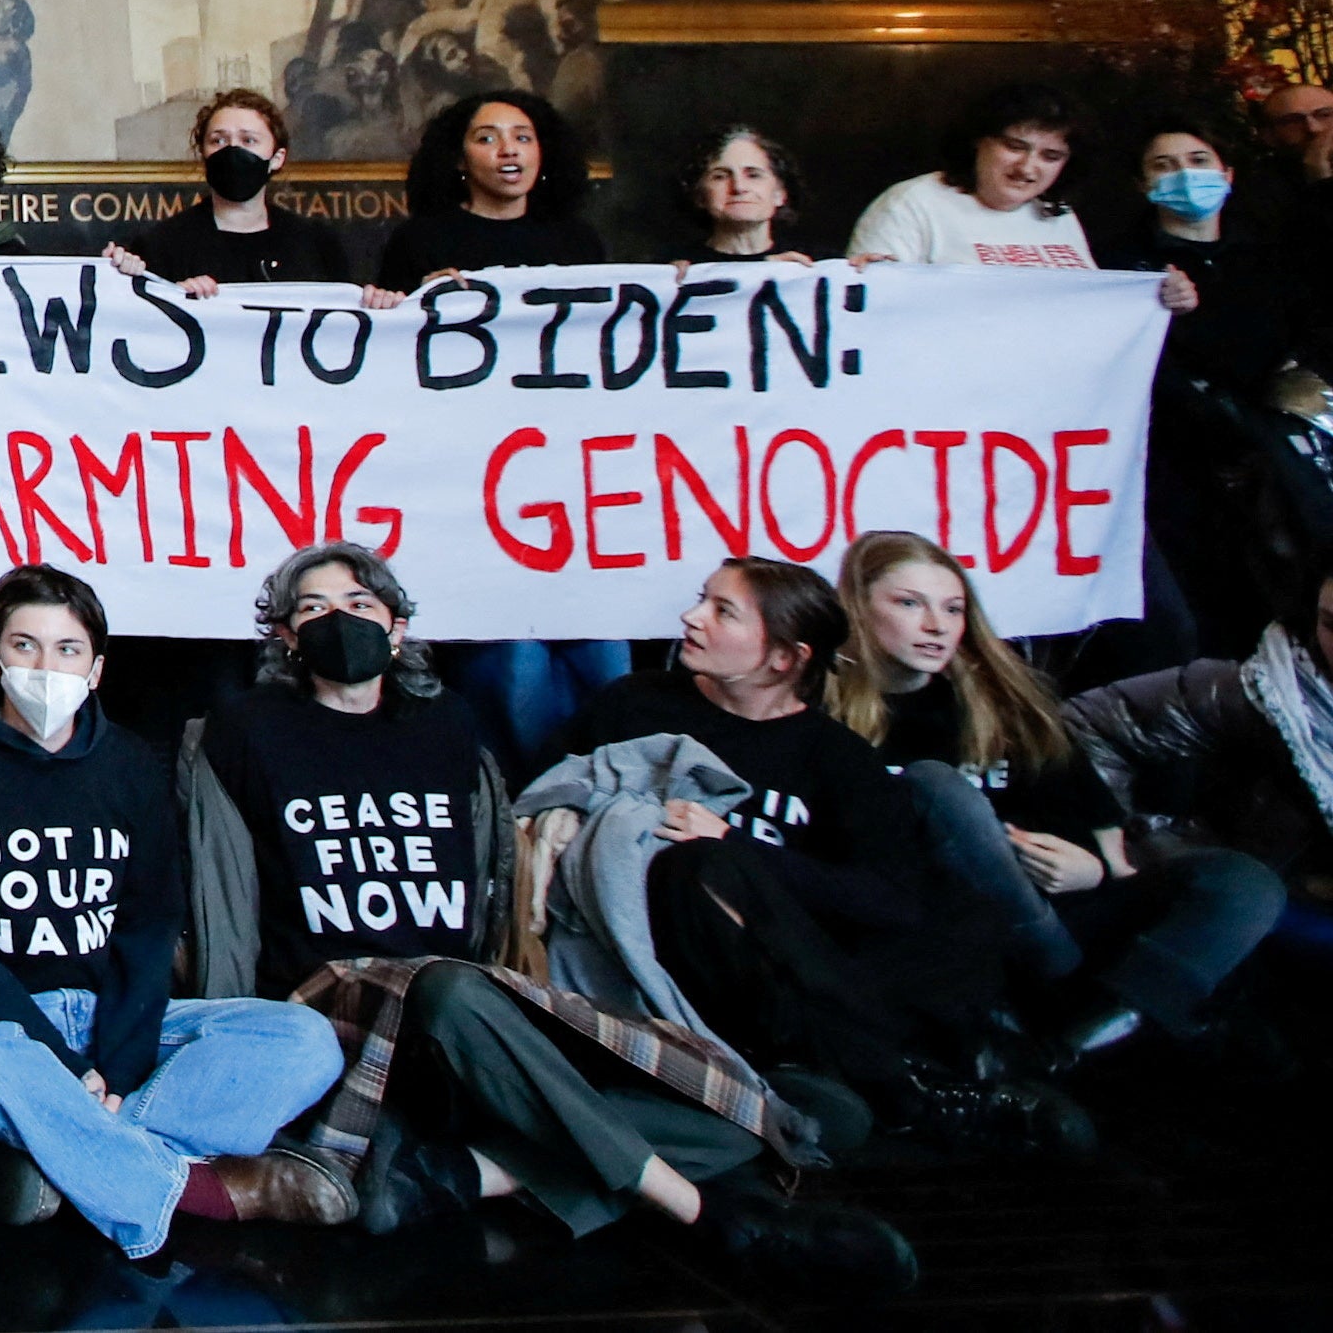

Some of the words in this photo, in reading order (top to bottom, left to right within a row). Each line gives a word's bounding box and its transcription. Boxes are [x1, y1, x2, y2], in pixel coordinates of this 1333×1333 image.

[70, 190, 203, 223] COMM
[272, 190, 409, 220] STATION
[241, 303, 373, 387] TO
[416, 276, 866, 393] BIDEN:
[483, 425, 1111, 576] GENOCIDE
[285, 792, 453, 834] CEASE
[92, 826, 130, 860] IN
[314, 835, 438, 876] FIRE
[0, 868, 114, 911] OUR
[300, 880, 467, 935] NOW
